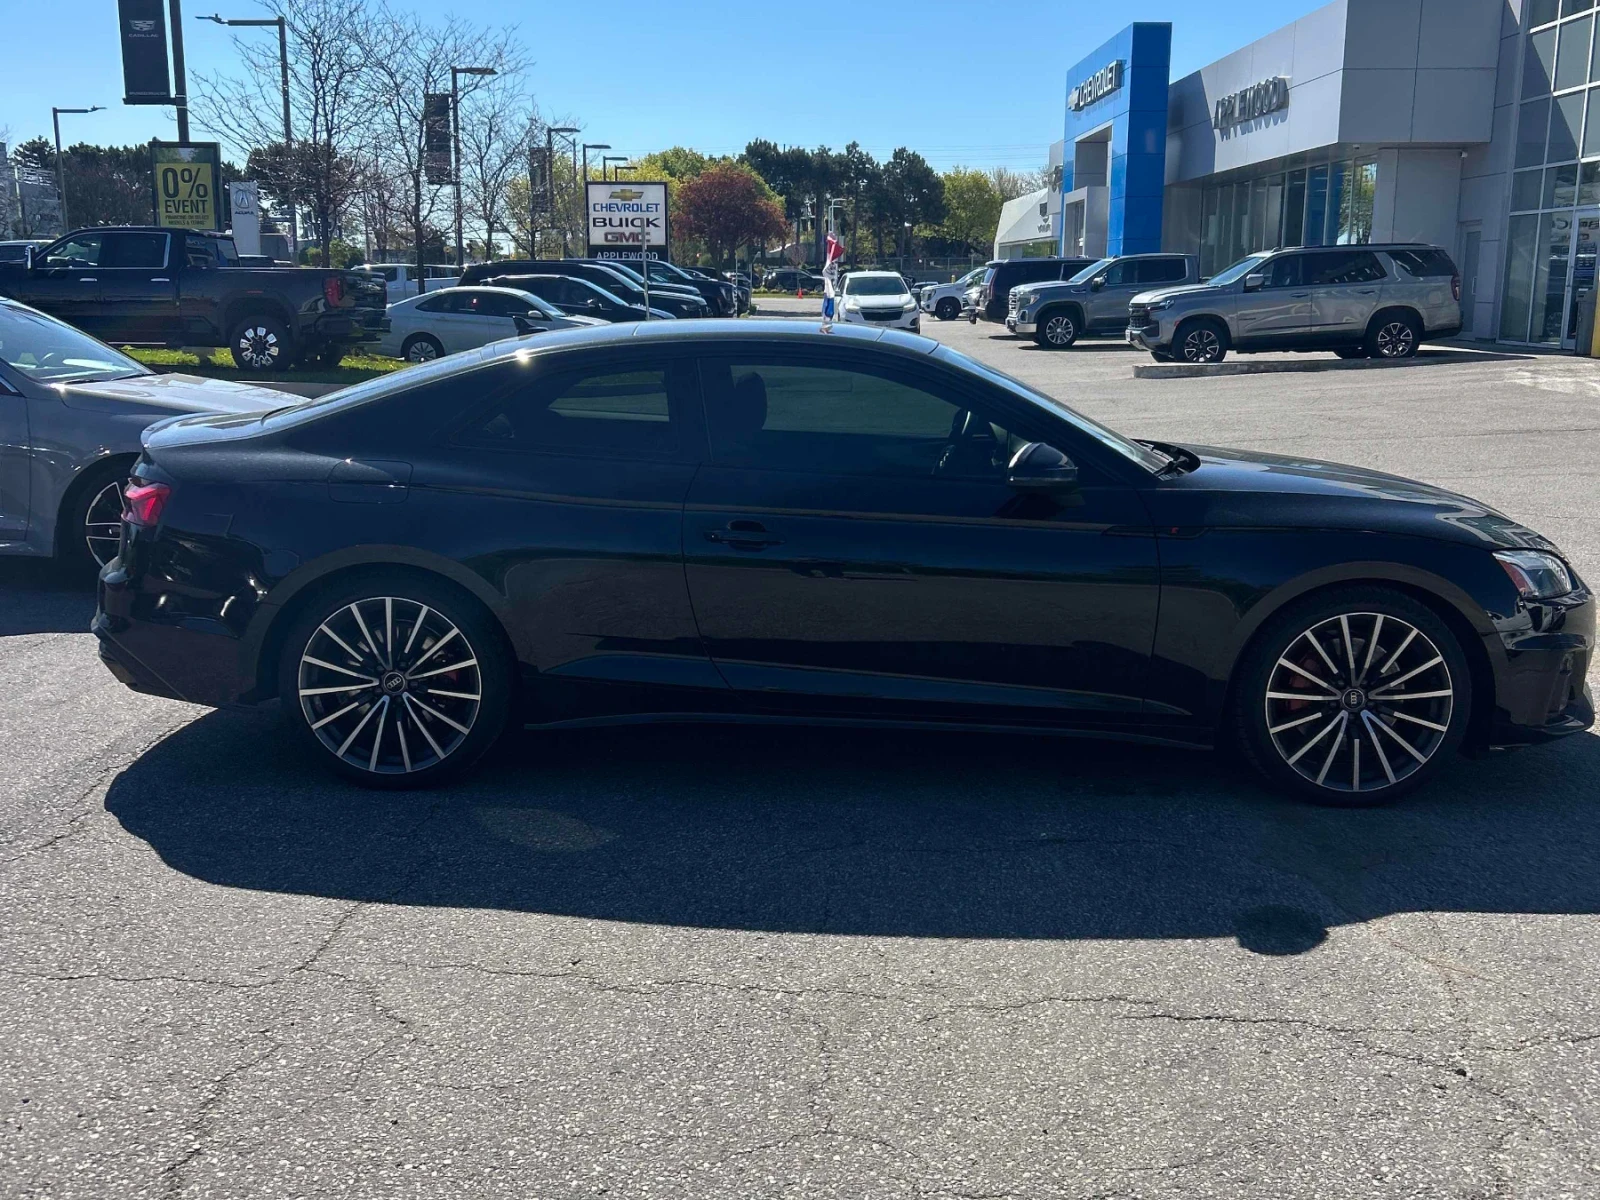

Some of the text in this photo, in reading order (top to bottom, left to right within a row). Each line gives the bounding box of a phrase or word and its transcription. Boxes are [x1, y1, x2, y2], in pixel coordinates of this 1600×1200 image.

[1079, 60, 1121, 107] CHEVROLET
[162, 167, 208, 199] 0%
[164, 199, 208, 214] EVENT
[593, 203, 660, 212] CHEVROLET
[592, 217, 661, 228] BUICK
[603, 231, 651, 243] GMC
